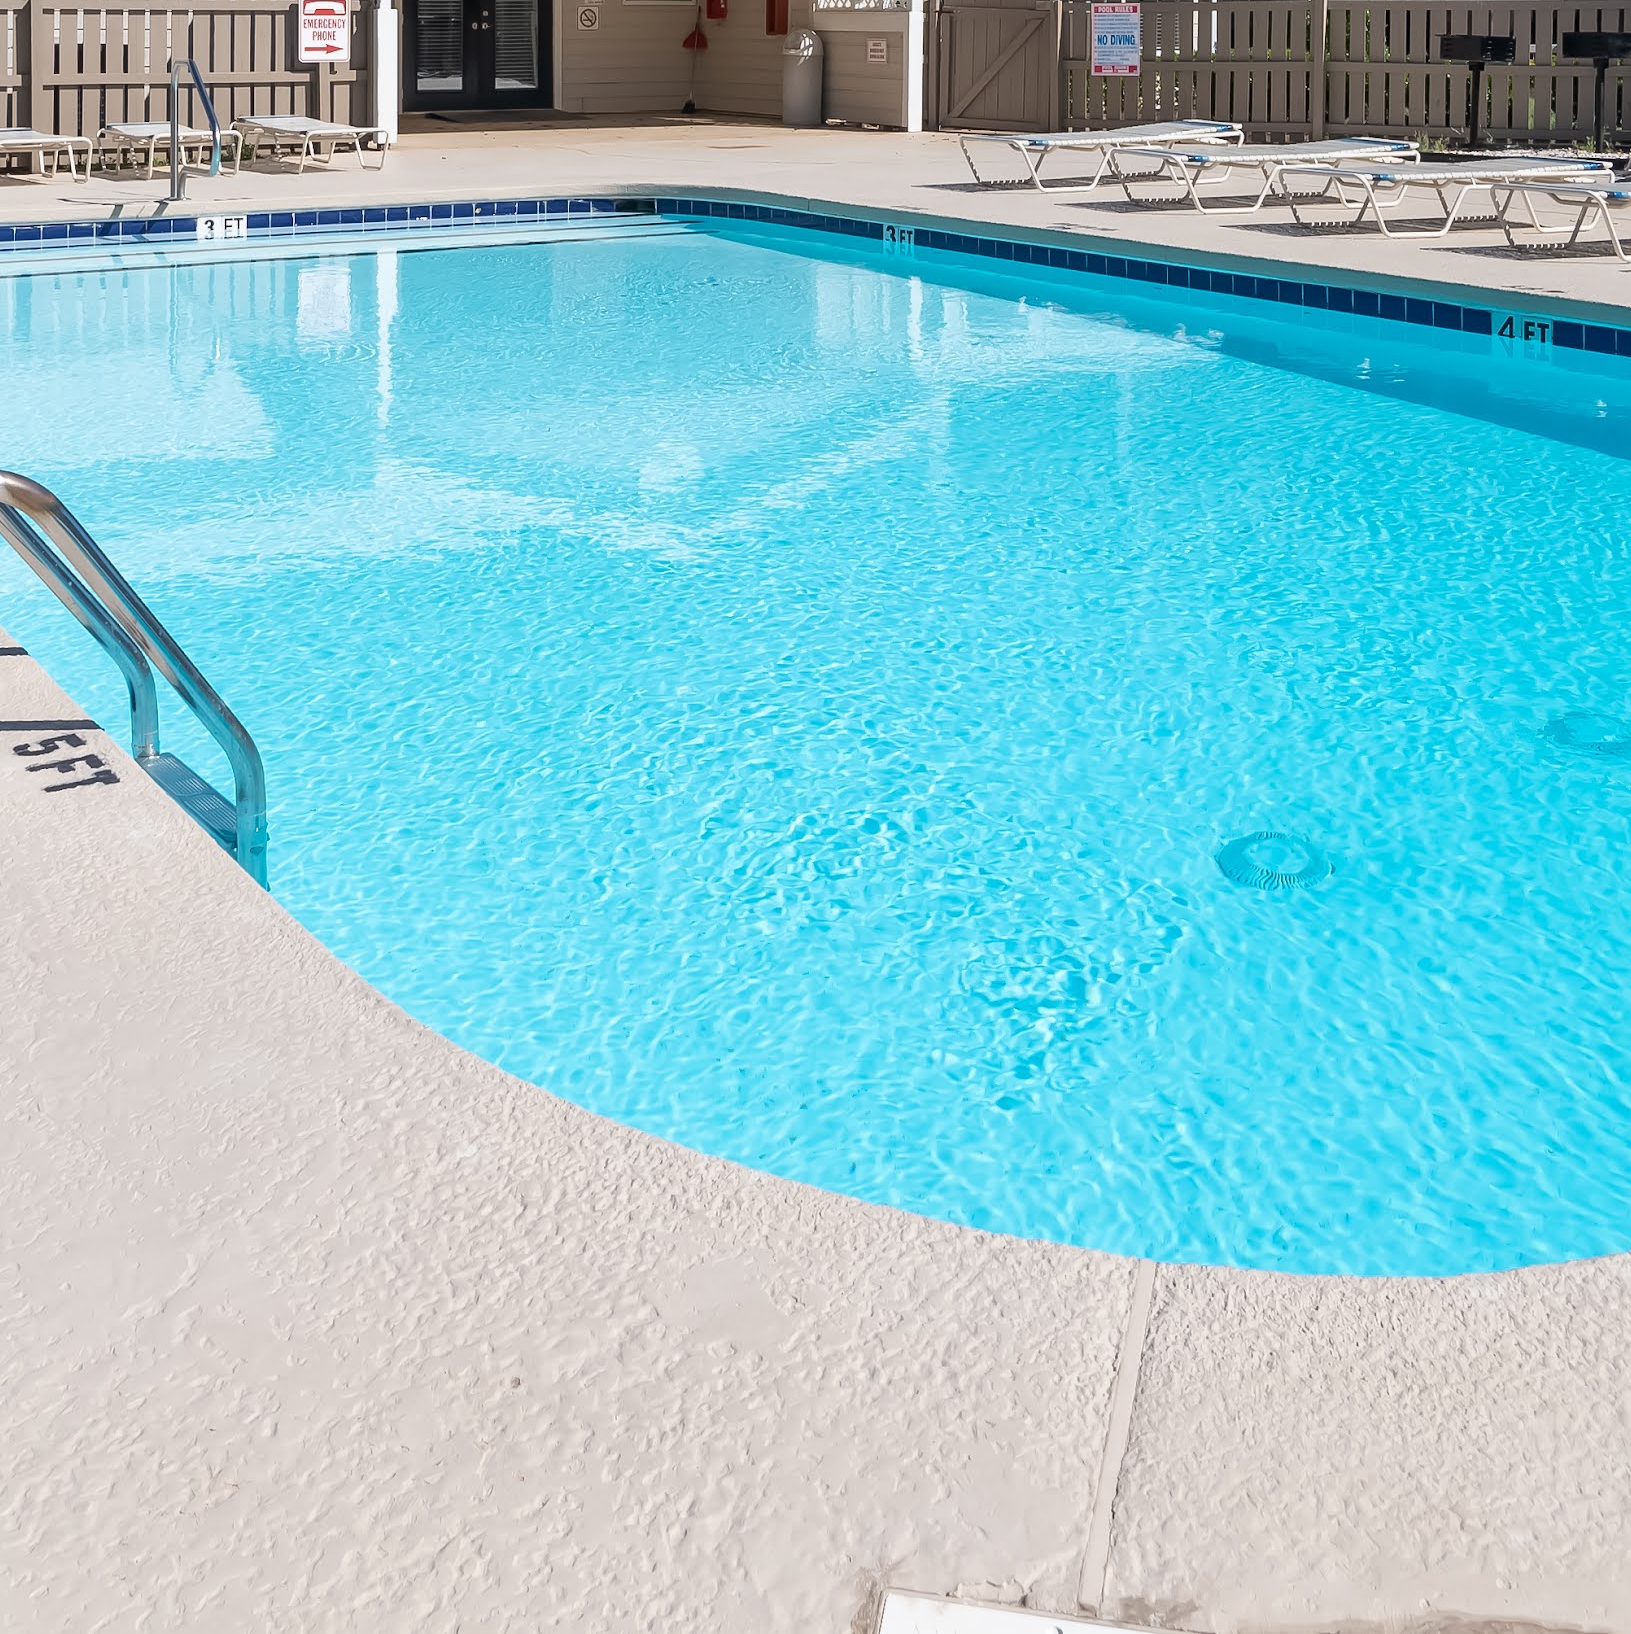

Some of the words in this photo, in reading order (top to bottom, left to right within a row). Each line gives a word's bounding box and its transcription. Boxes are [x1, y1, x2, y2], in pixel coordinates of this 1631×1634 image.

[303, 18, 346, 29] EMERGENCY
[312, 30, 337, 41] PHONE
[1097, 34, 1108, 46] NO
[1110, 34, 1136, 46] DIVING
[204, 219, 215, 234] 3
[224, 217, 244, 233] FT
[886, 225, 897, 242] 3
[899, 229, 914, 245] FT
[1497, 315, 1516, 339] 4
[1524, 319, 1550, 344] FT
